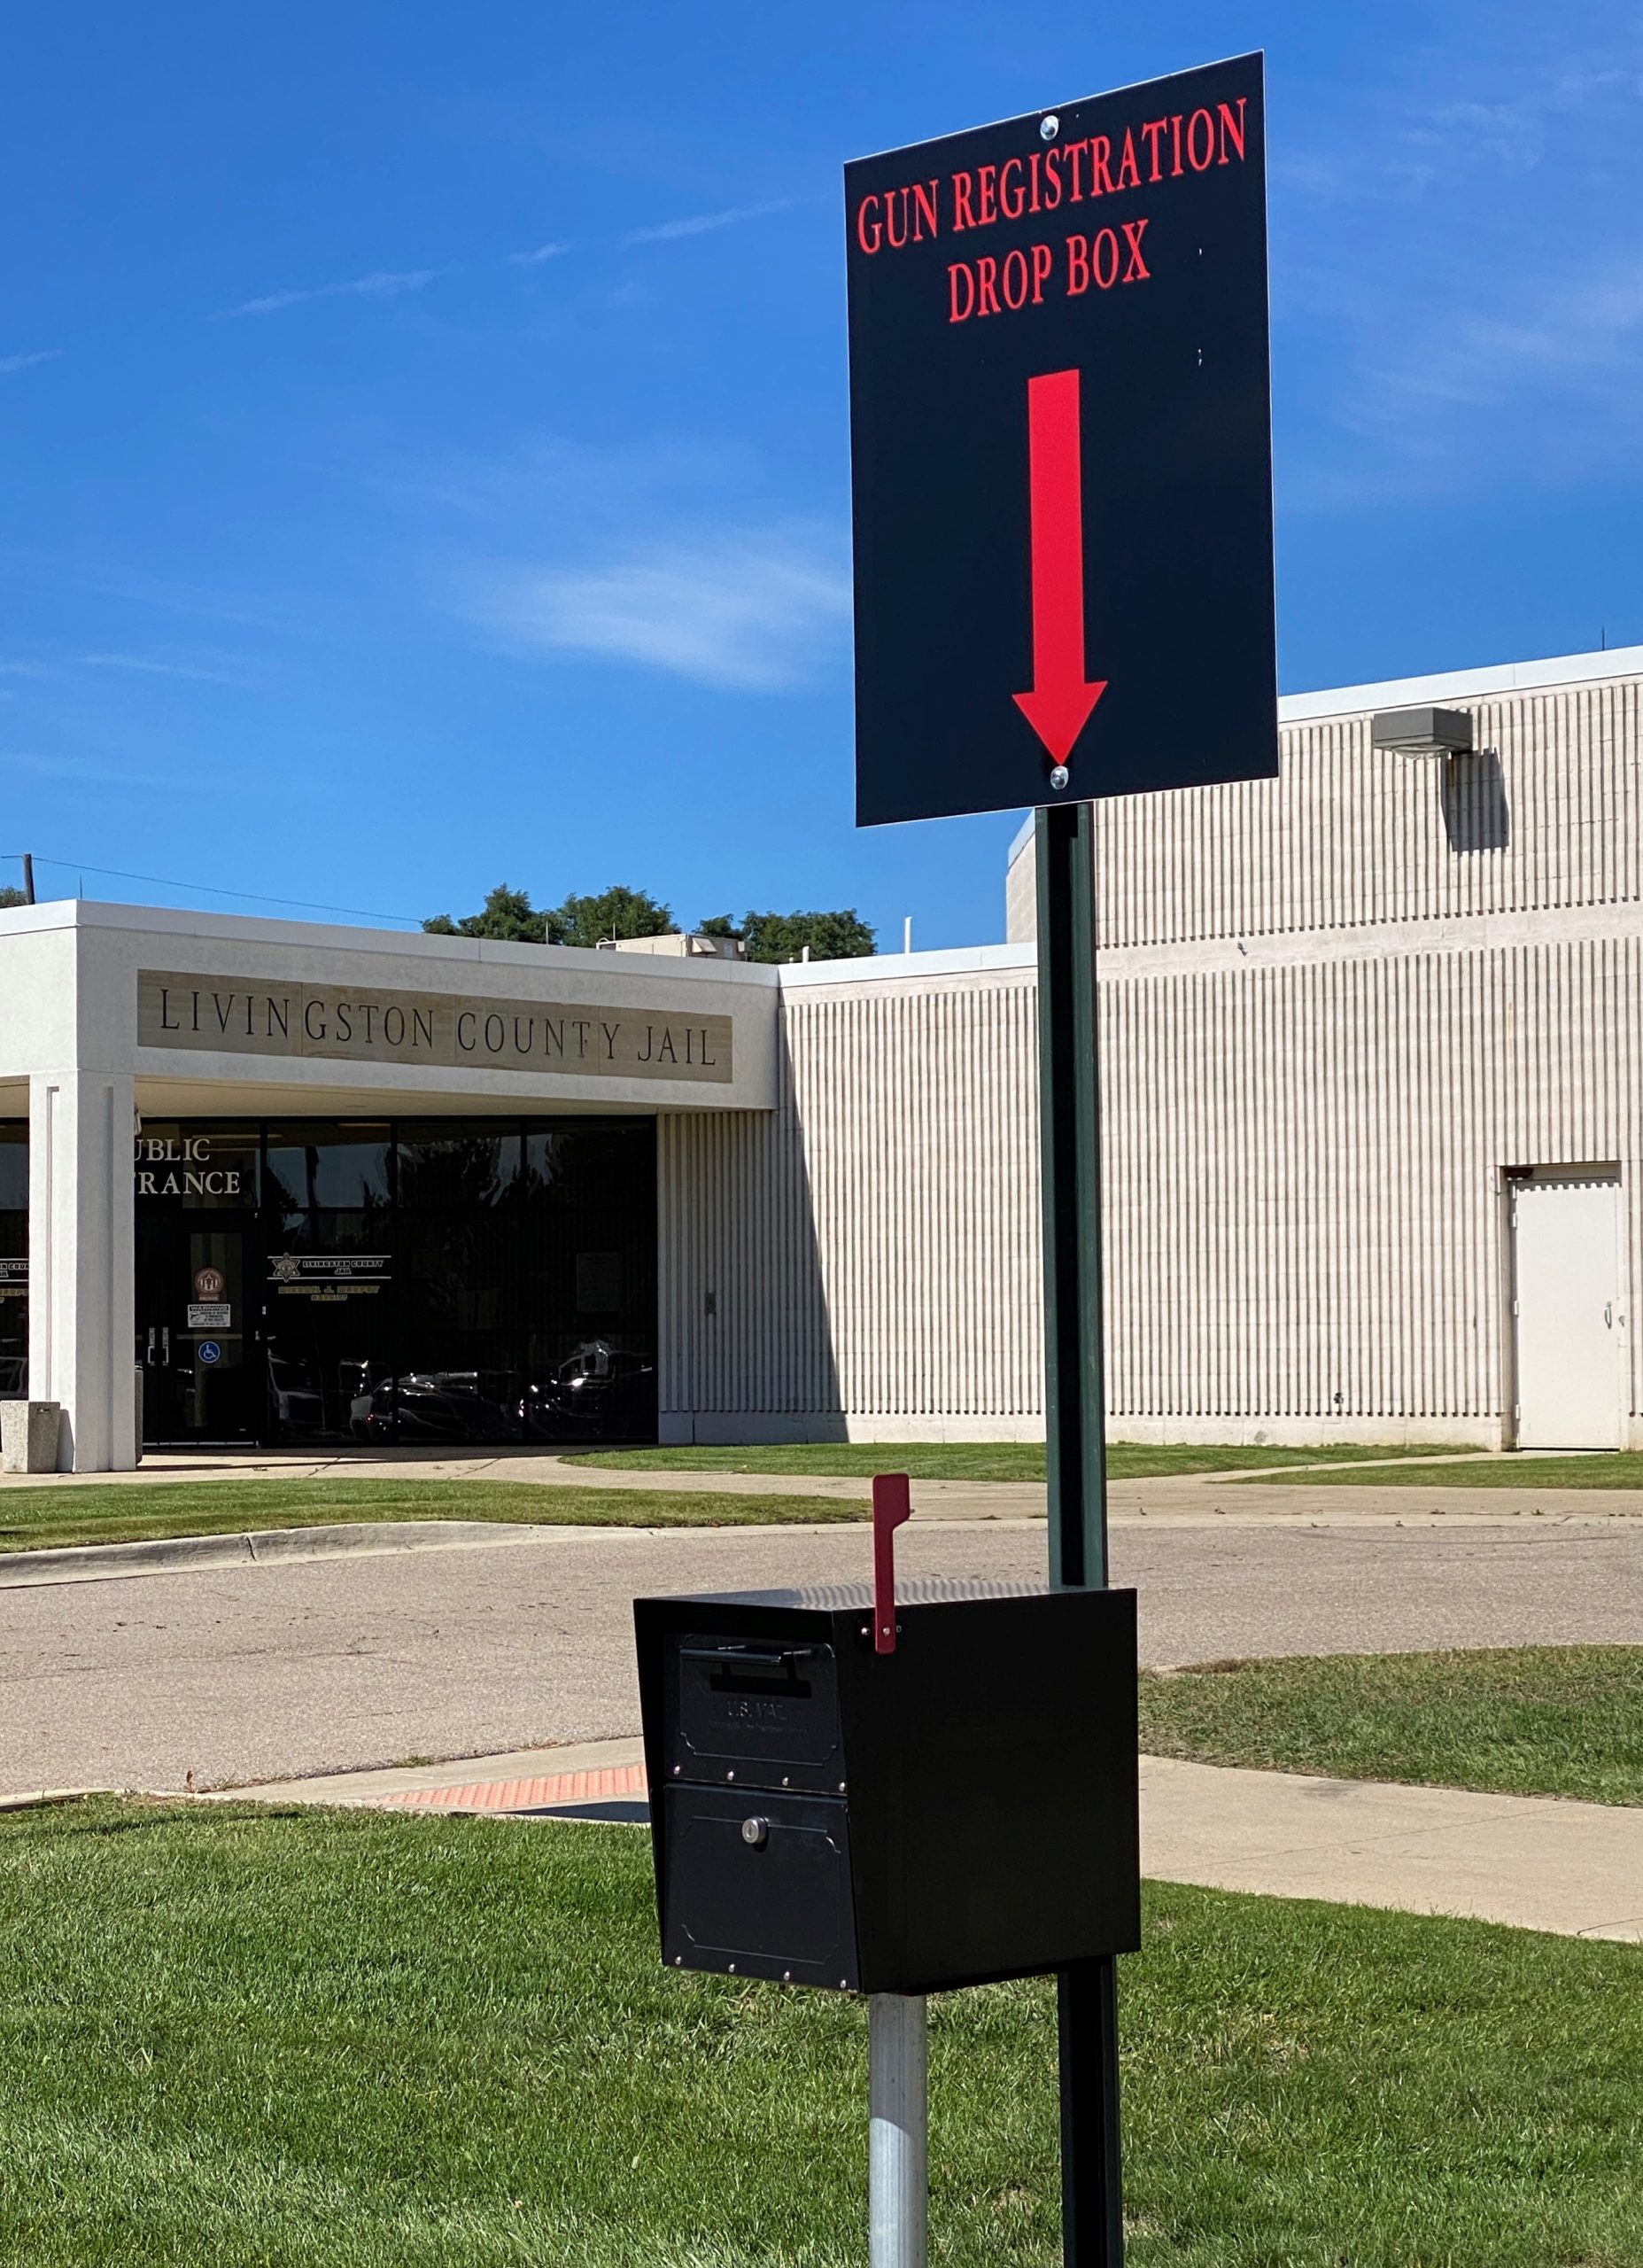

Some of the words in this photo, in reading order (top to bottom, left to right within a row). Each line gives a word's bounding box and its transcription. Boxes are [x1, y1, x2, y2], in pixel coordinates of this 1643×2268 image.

[857, 179, 939, 254] GUN
[952, 97, 1247, 232] REGISTRATION
[948, 245, 1052, 323] DROP
[1066, 218, 1151, 296] BOX
[160, 989, 434, 1049] LIVINGSTON
[457, 1012, 622, 1060] COUNTY
[637, 1026, 717, 1067] JAIL
[135, 1138, 210, 1161] BLIC
[136, 1171, 240, 1195] RANCE
